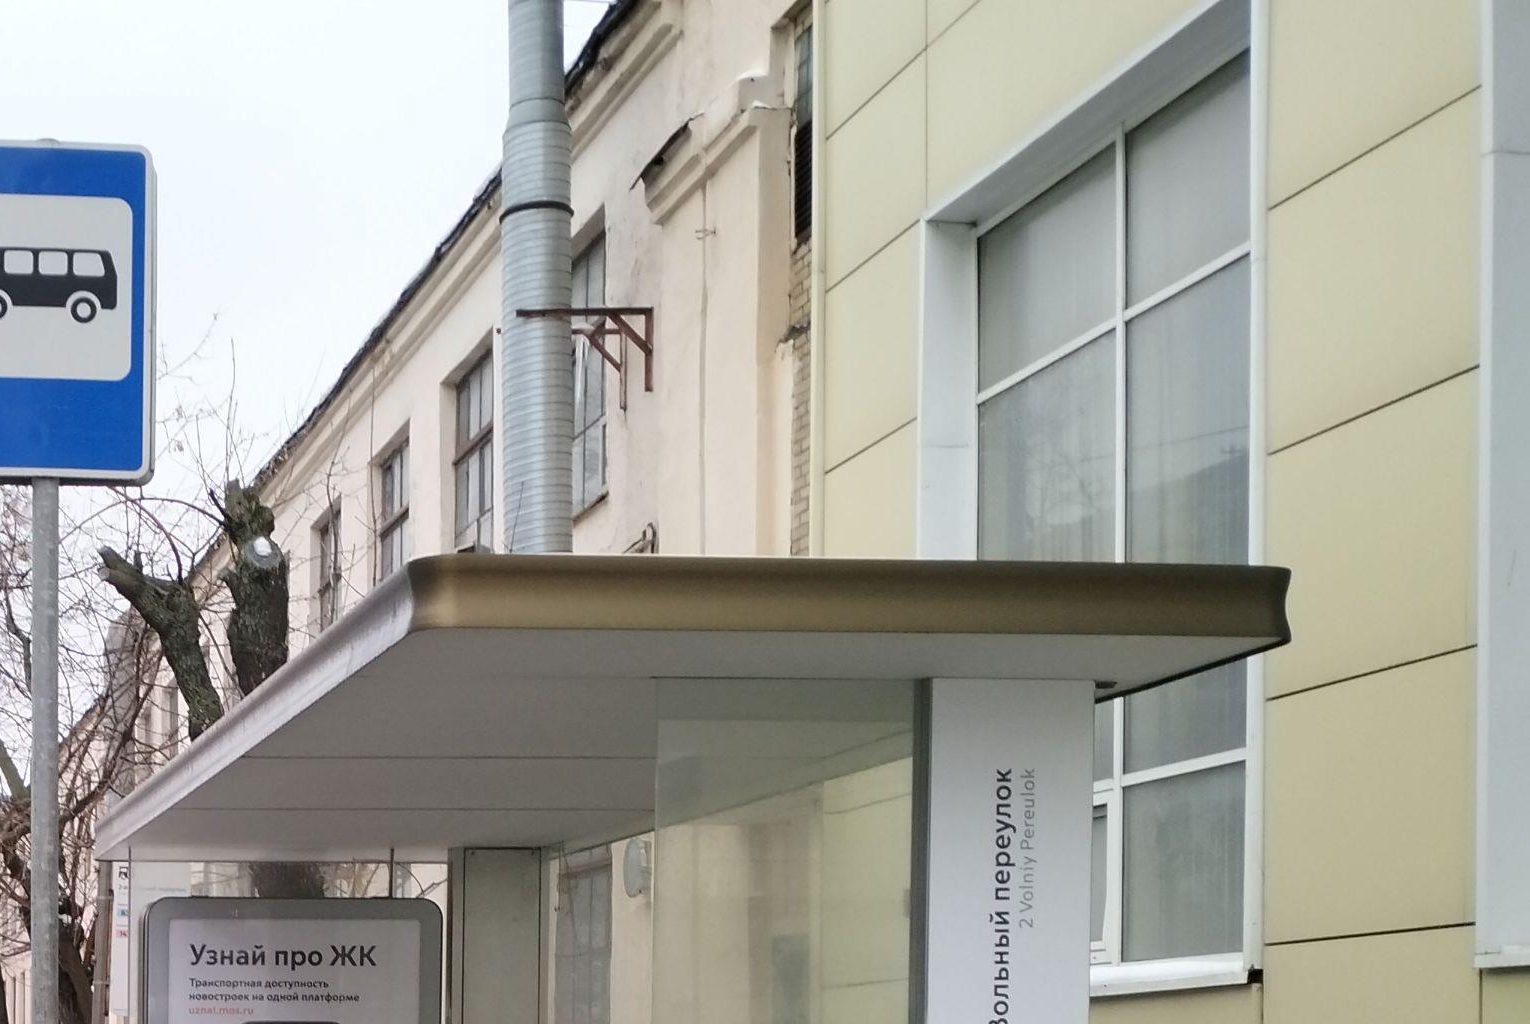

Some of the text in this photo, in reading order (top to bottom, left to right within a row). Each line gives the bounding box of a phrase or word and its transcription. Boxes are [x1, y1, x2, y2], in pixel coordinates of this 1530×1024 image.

[994, 768, 1017, 901] переулок
[1019, 768, 1038, 928] 2 Volniy Pereulok
[189, 943, 377, 971] Узнай про ЖК
[189, 977, 329, 989] Транспортная доступность
[189, 993, 250, 1003] новостроек
[266, 992, 299, 1002] одной
[301, 993, 360, 1003] платформе
